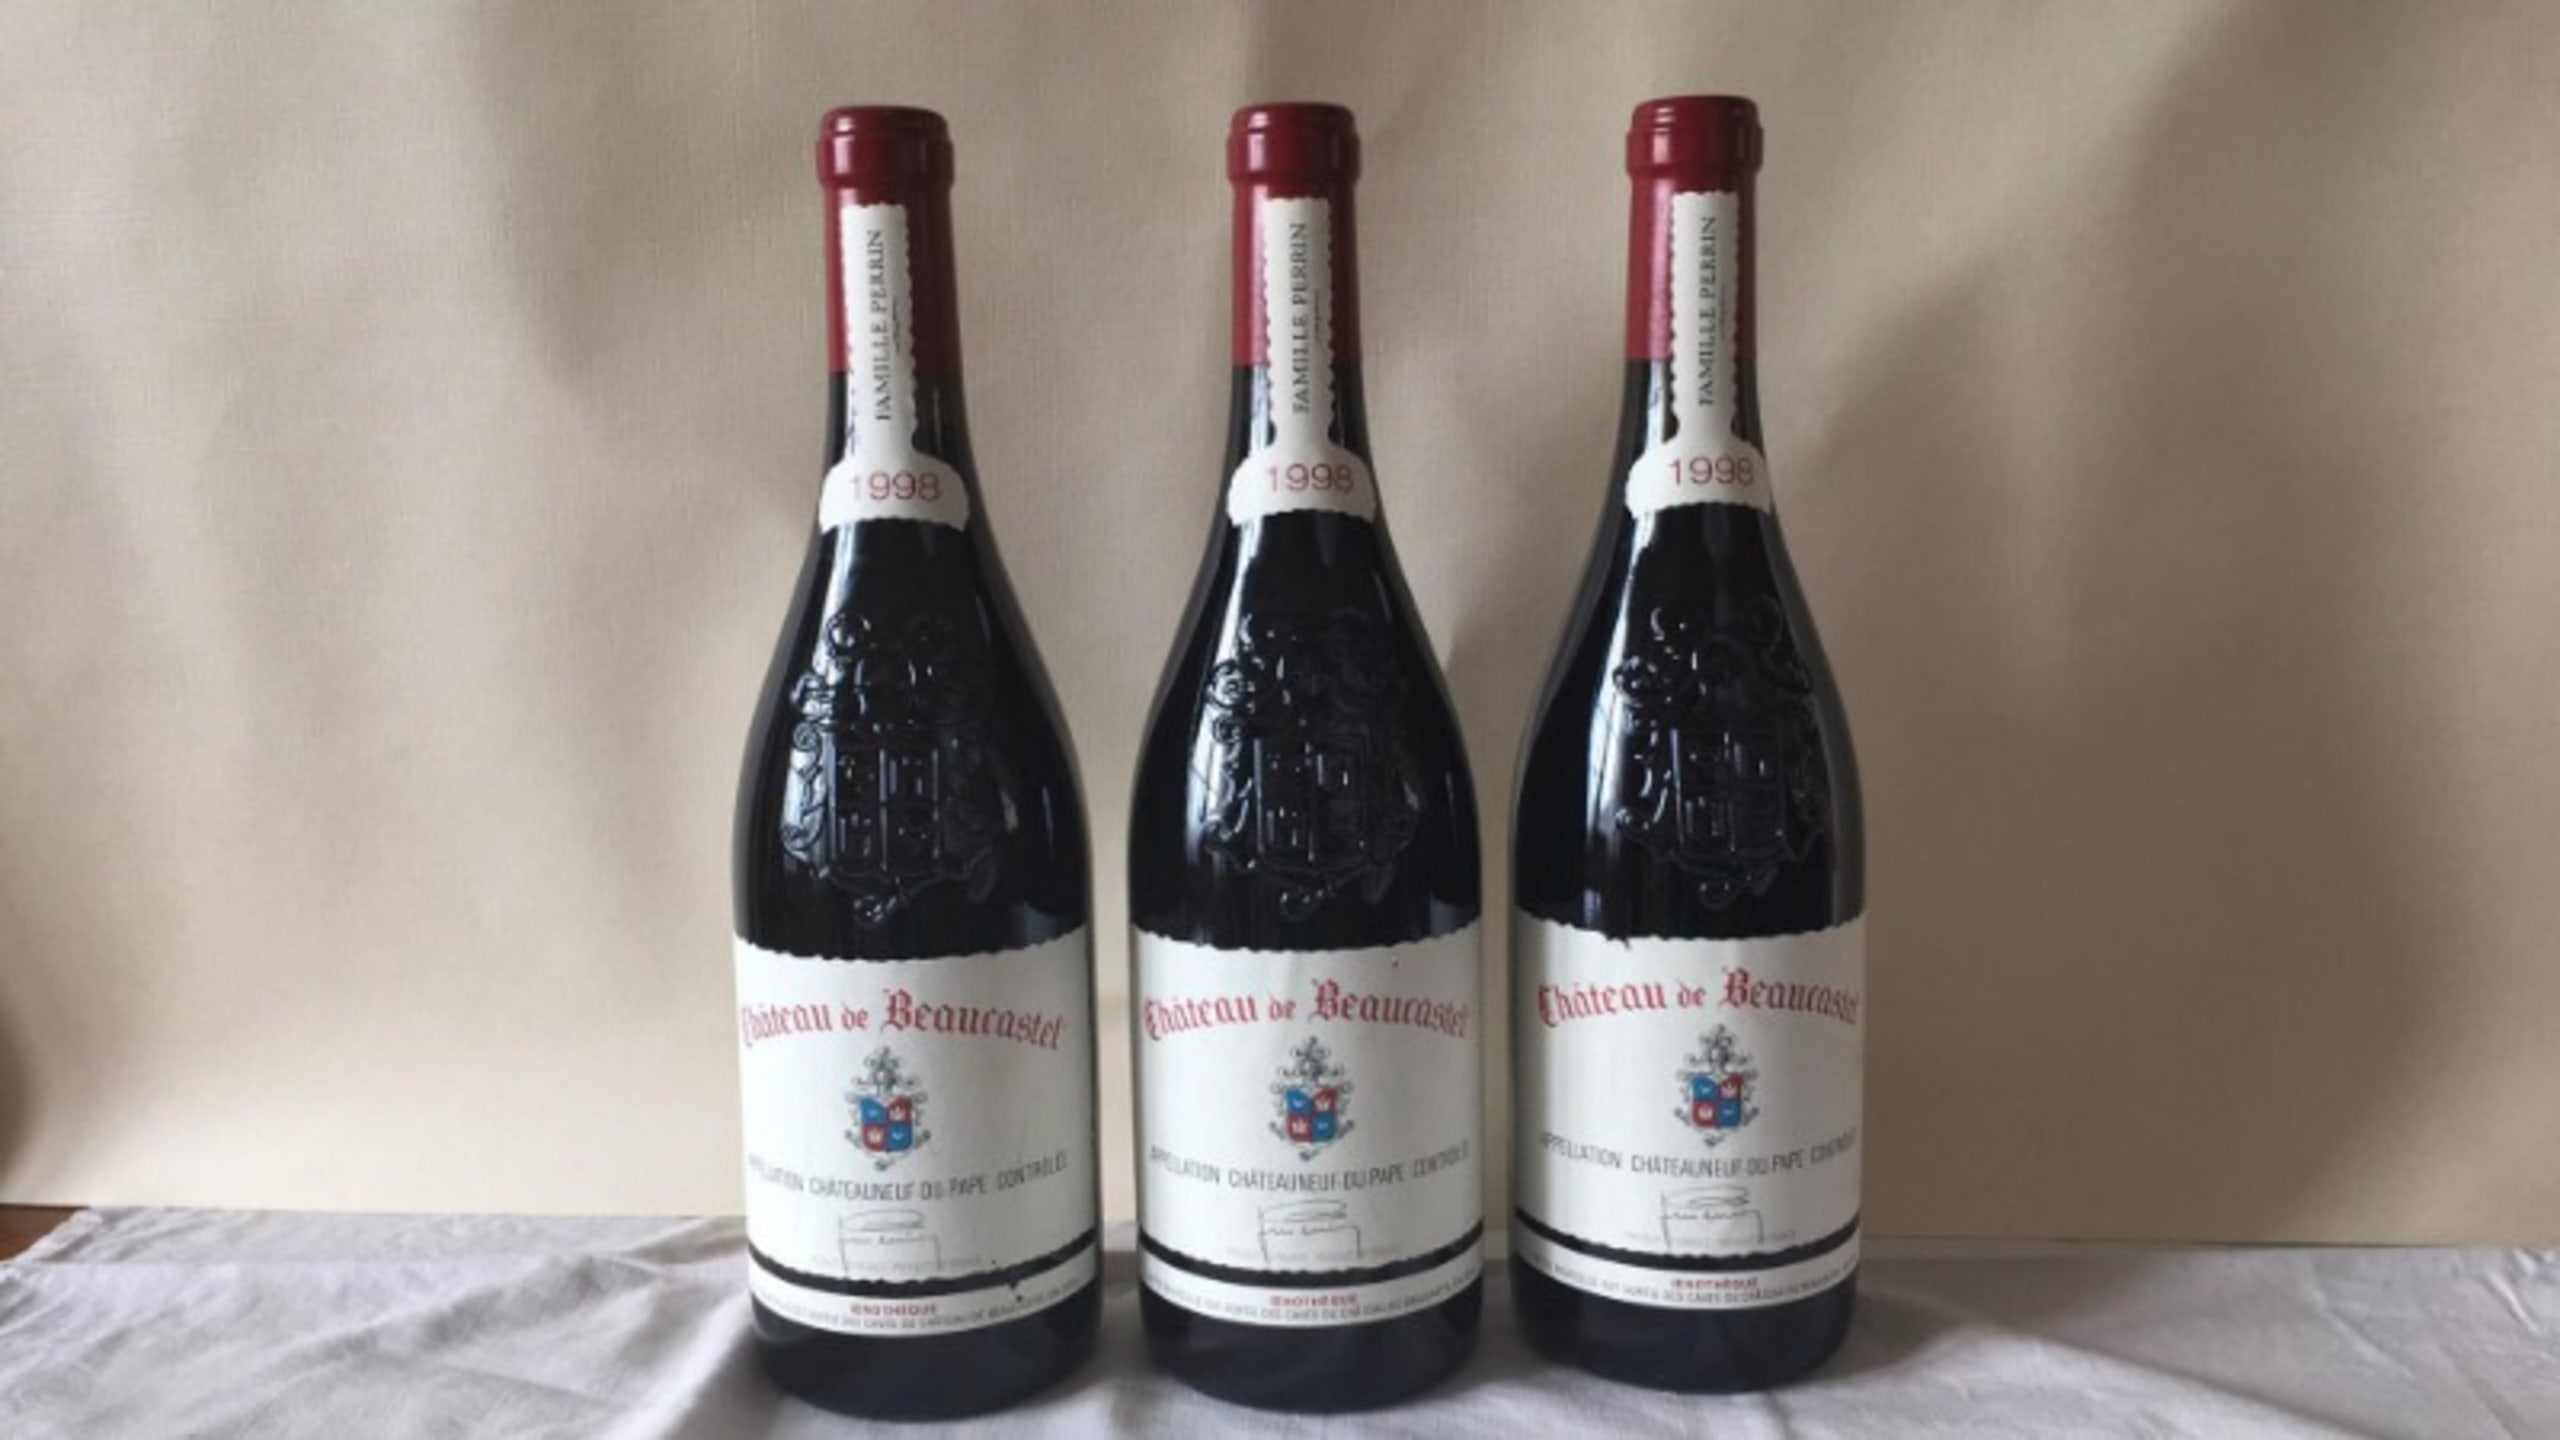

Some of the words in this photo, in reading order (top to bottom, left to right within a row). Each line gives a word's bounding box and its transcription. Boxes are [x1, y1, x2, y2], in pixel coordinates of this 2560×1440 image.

[867, 229, 888, 314] PERRIN
[1290, 223, 1309, 305] PERRIN
[1699, 215, 1717, 299] PERRIN
[870, 317, 891, 421] FAMILLE
[1292, 316, 1310, 414] FAMILLE
[1698, 306, 1716, 407] FAMILLE
[850, 472, 942, 502] 1998
[1267, 463, 1355, 493] 1998
[1670, 456, 1755, 486] 1998
[841, 1001, 869, 1031] de
[880, 988, 1065, 1050] Beaucastel
[1145, 995, 1260, 1041] Château
[1268, 995, 1297, 1022] de
[1307, 978, 1468, 1037] Beaucastel
[1537, 982, 1668, 1027] Château
[1677, 976, 1706, 1007] de
